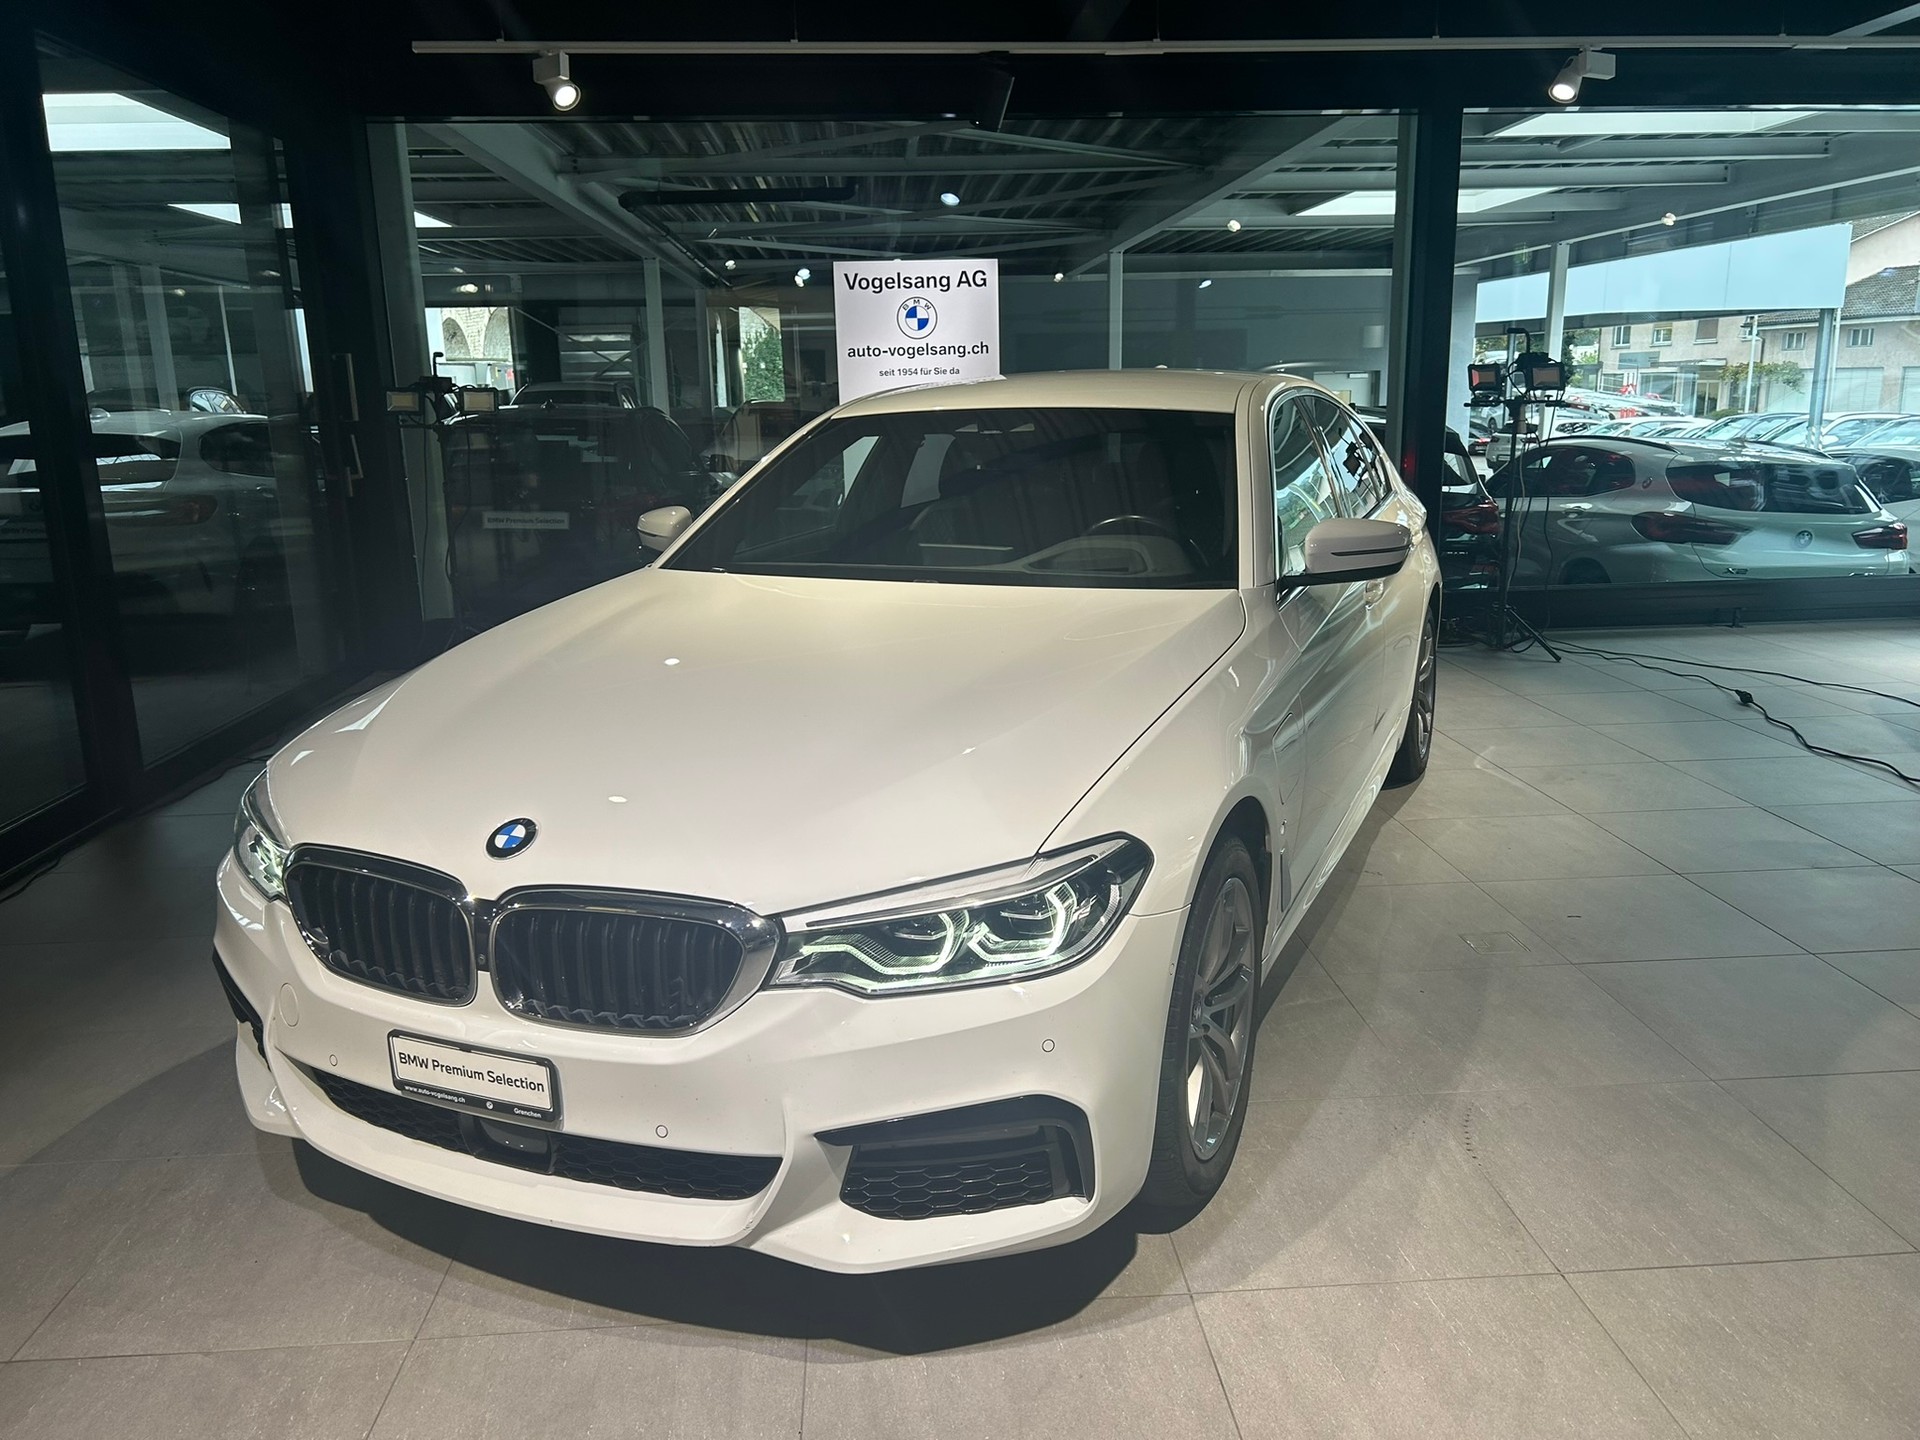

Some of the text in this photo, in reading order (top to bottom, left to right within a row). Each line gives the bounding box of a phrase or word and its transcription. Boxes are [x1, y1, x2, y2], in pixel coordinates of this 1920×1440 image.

[844, 270, 987, 294] Vogelsang AG
[902, 299, 932, 311] BMW
[847, 341, 989, 359] auto-vogelsang.ch
[879, 369, 895, 377] seit
[898, 368, 918, 376] 1954
[934, 367, 947, 375] Sie
[949, 367, 960, 375] da
[1722, 566, 1749, 575] X2
[398, 1051, 545, 1093] BMW Premium Selection
[404, 1085, 542, 1118] www.auto-vogelsang.ch Grenchen
